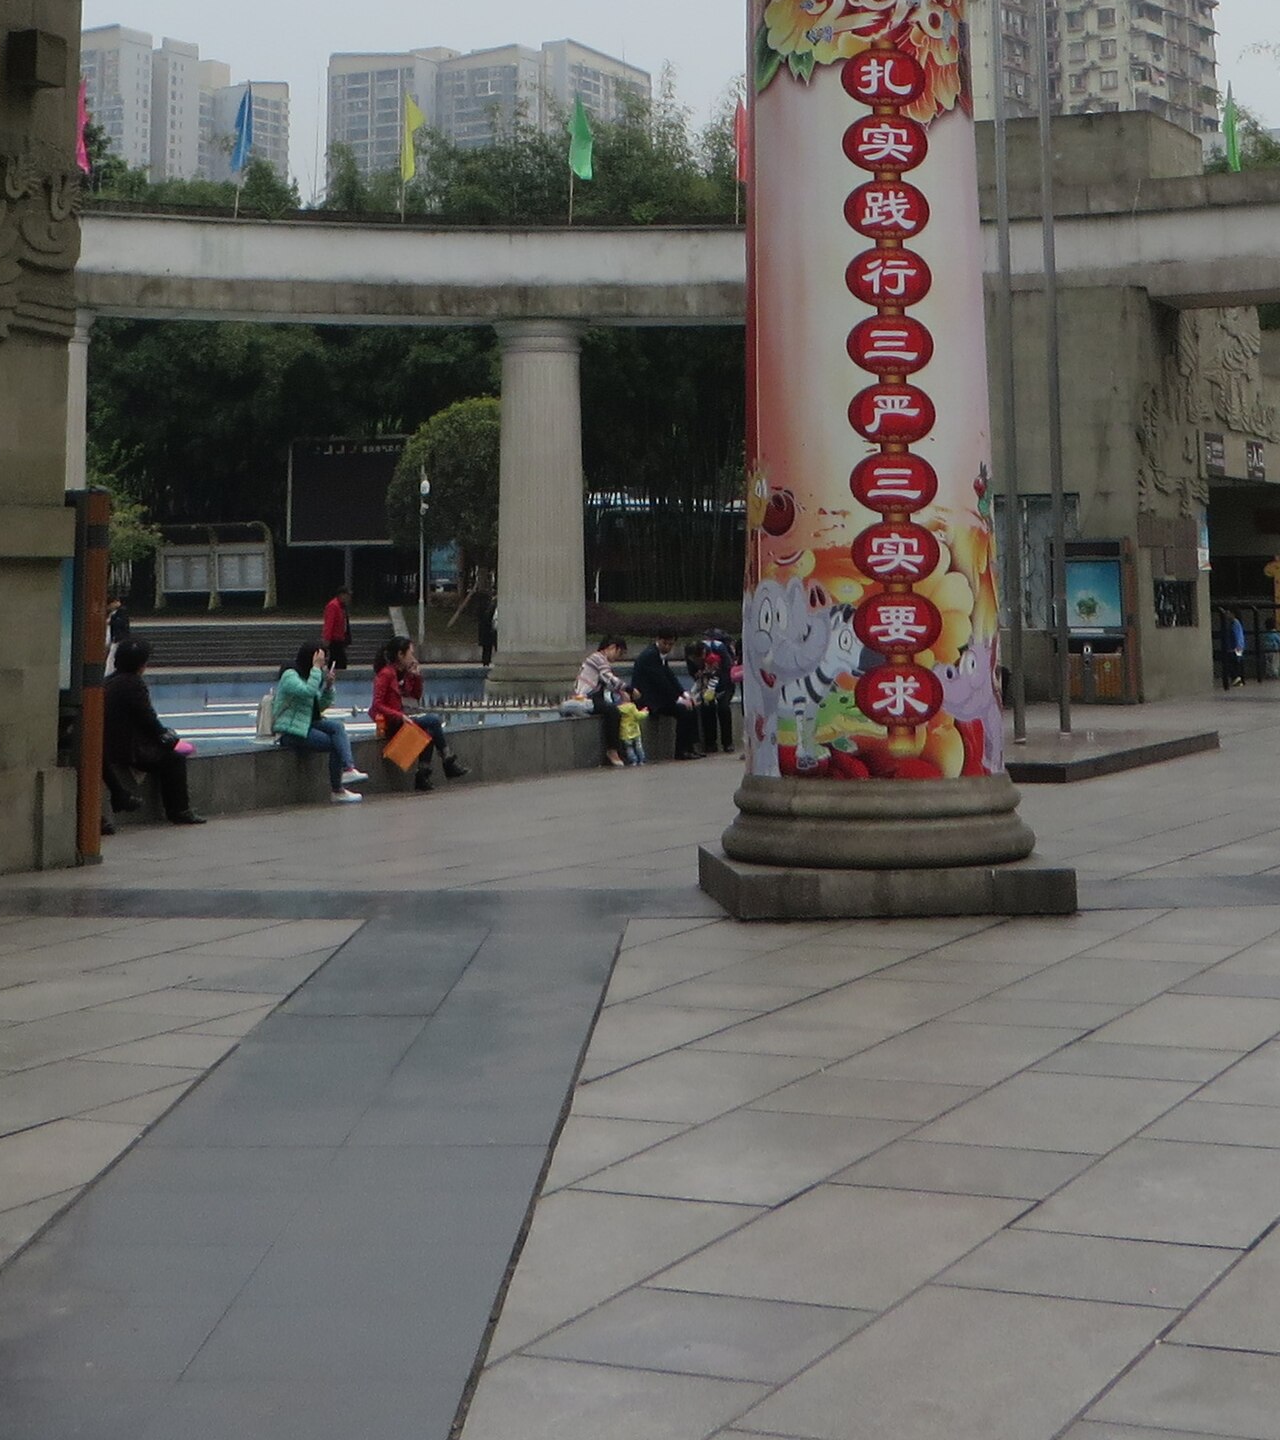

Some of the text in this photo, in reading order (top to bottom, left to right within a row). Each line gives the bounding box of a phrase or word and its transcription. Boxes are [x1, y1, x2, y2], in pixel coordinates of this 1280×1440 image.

[857, 59, 929, 716] 扎实践行三严三实要求
